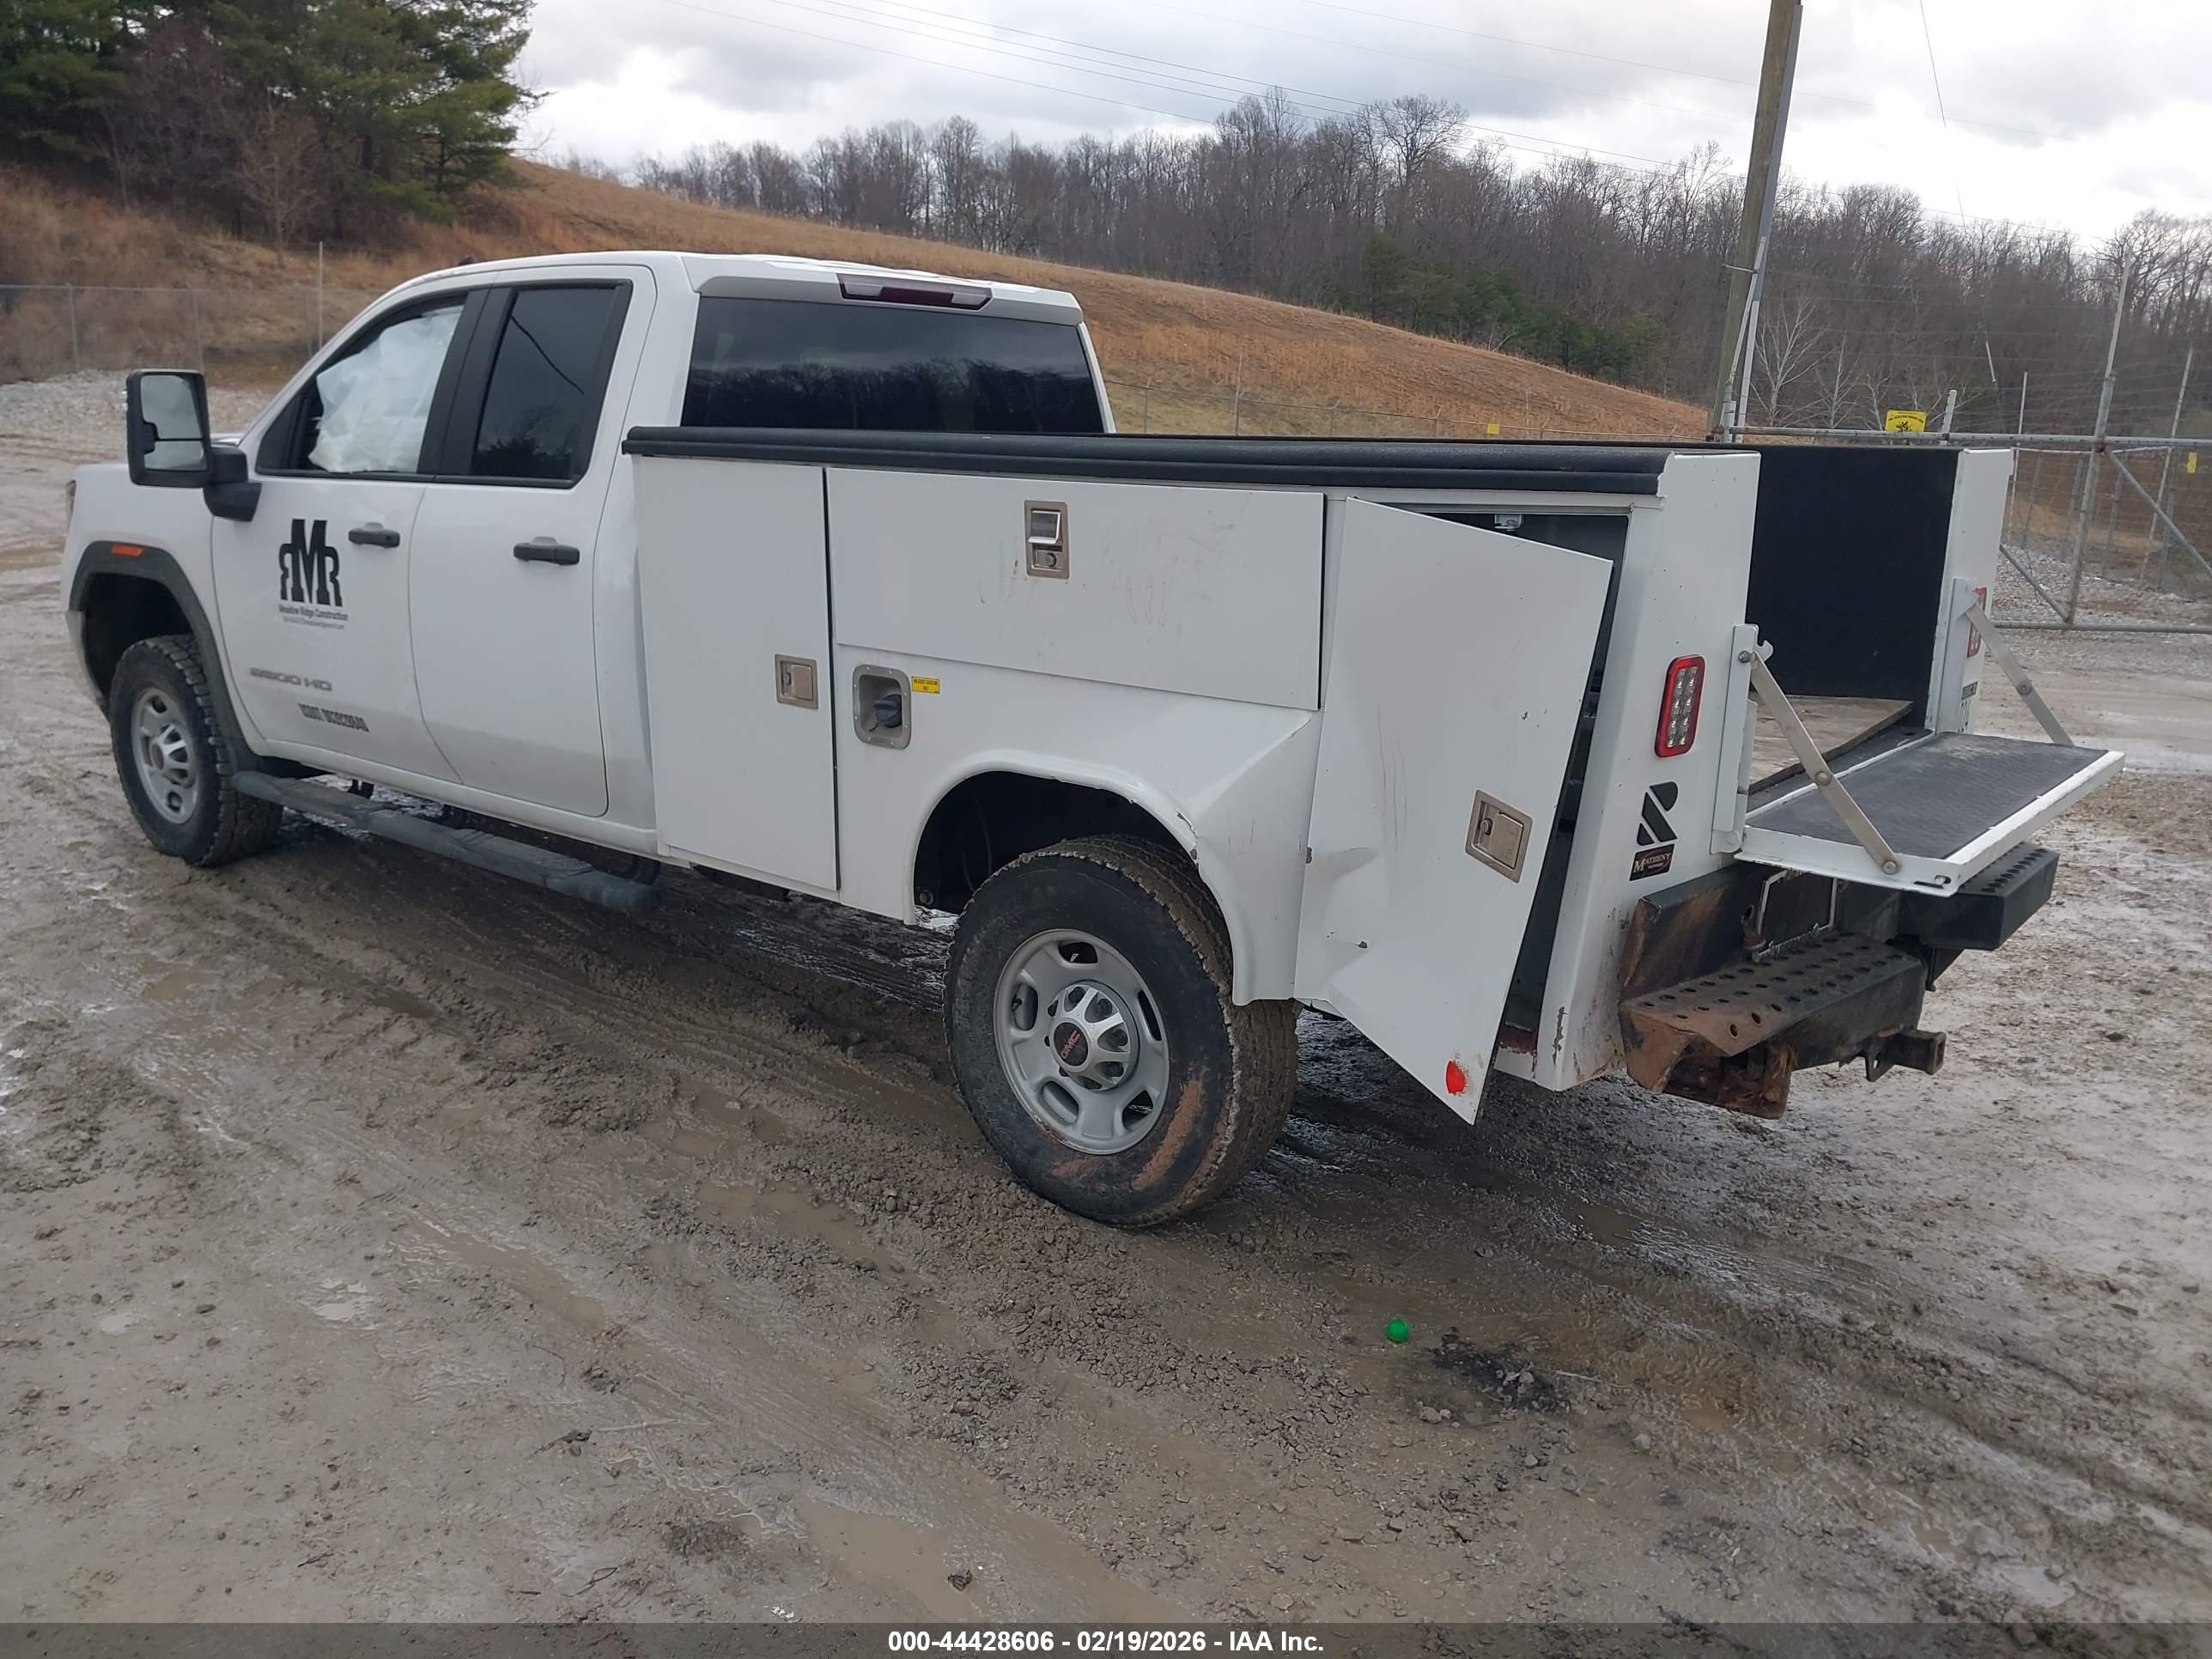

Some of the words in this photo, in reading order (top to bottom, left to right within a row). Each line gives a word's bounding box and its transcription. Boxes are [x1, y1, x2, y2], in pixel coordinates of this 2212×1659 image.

[315, 608, 349, 622] Construction
[304, 678, 332, 692] HD
[1060, 1030, 1080, 1060] GMC
